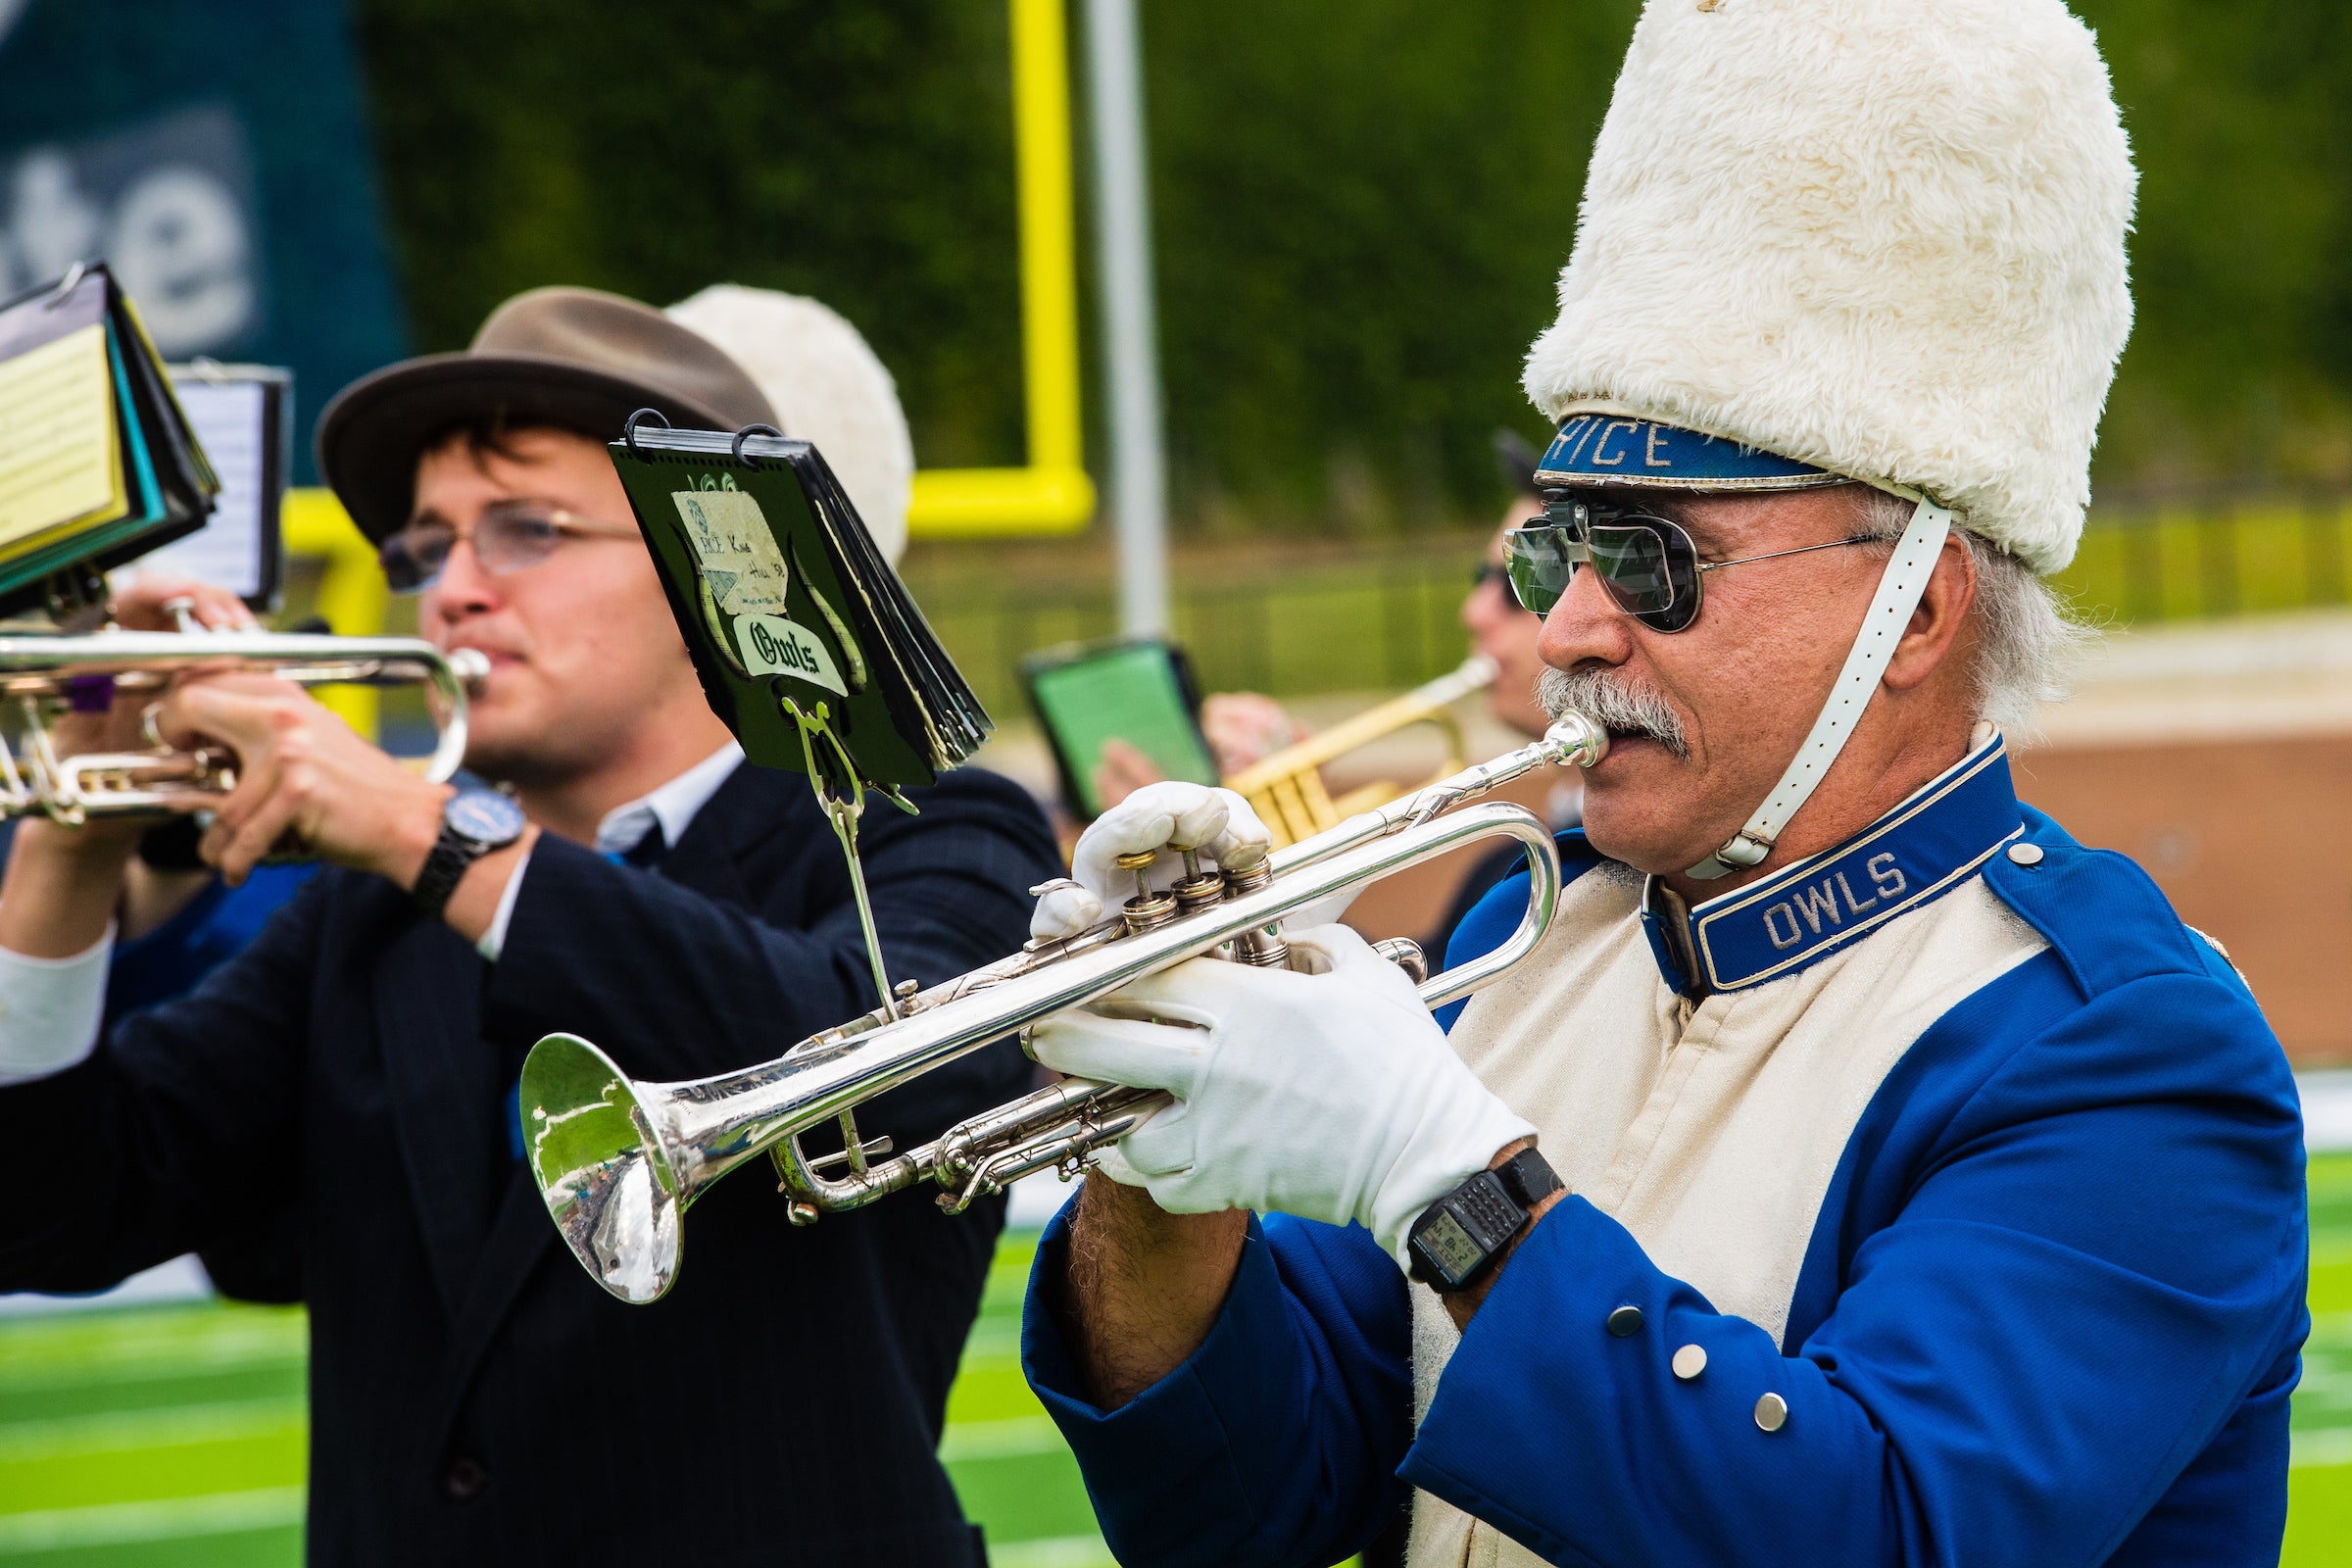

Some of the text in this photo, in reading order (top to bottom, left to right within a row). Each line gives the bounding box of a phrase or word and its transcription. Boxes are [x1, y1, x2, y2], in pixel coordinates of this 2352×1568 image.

[1543, 415, 1672, 467] RICE
[750, 621, 820, 674] Owls
[1763, 852, 1907, 951] OWLS
[1443, 1237, 1469, 1263] 2:48
